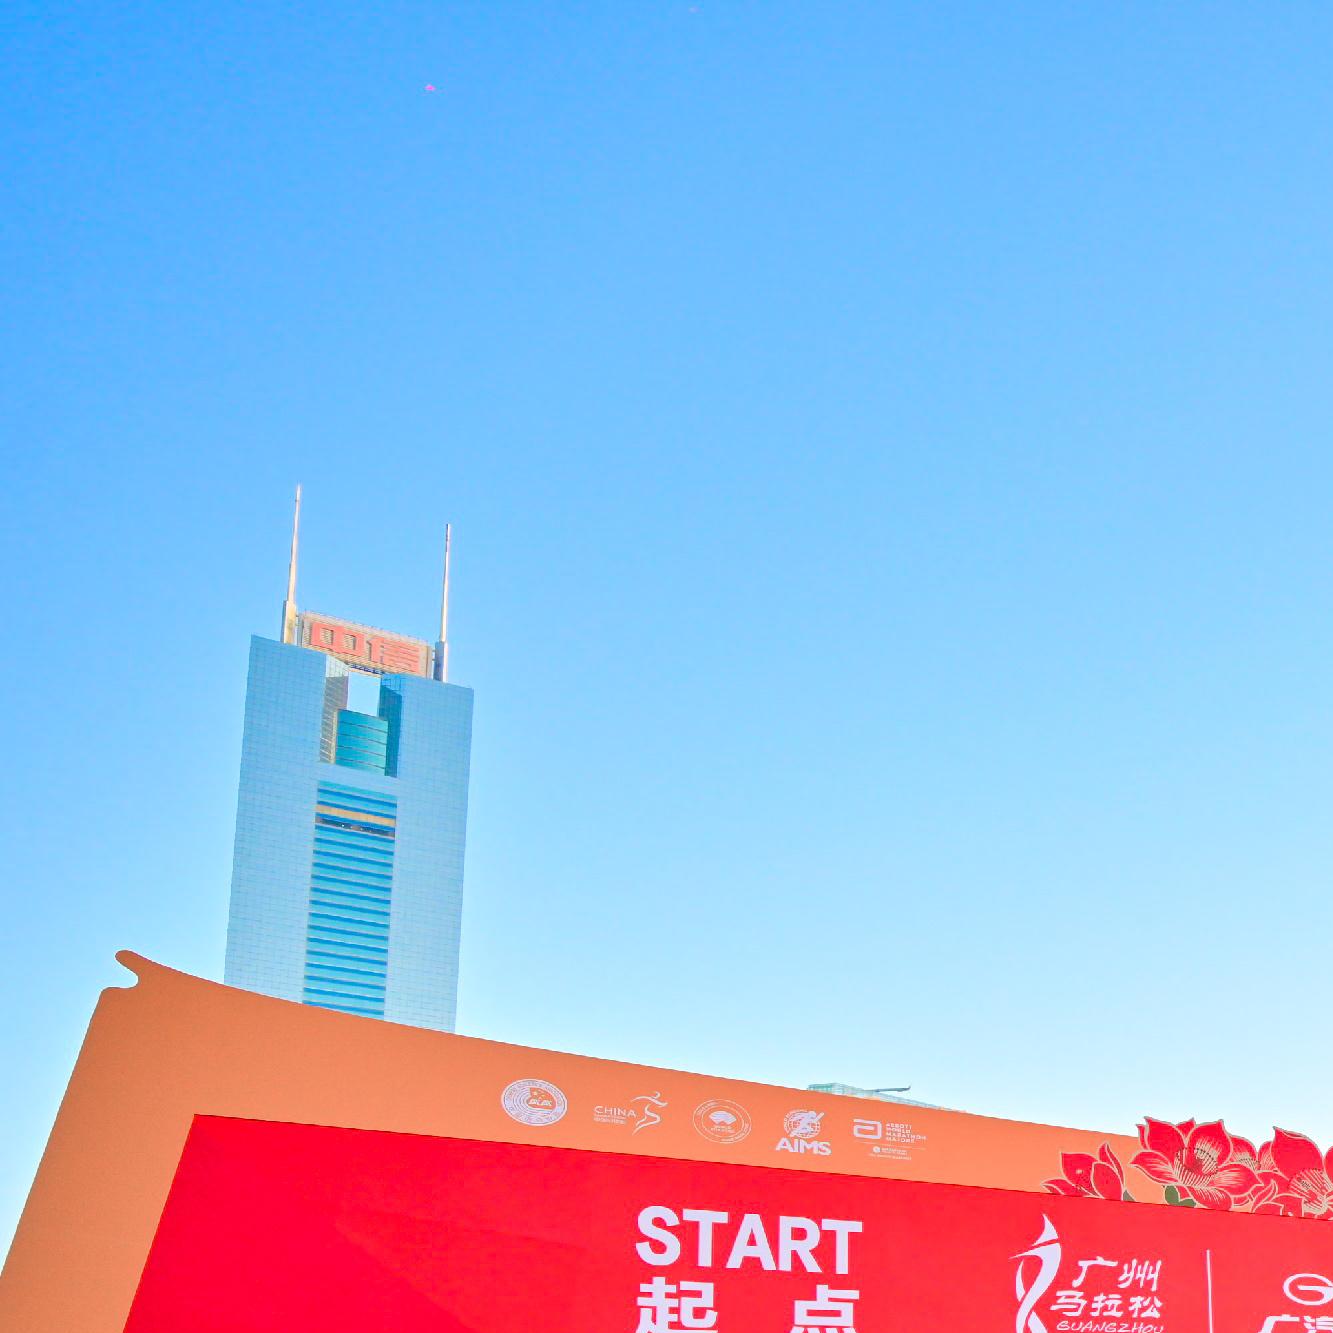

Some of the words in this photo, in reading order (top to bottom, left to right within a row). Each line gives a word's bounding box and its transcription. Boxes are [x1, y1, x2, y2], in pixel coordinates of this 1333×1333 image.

[311, 622, 420, 673] 中信
[594, 1105, 637, 1118] CHINA
[775, 1138, 832, 1156] AIMS
[635, 1206, 863, 1275] START
[1072, 1256, 1161, 1289] 广州
[1050, 1290, 1162, 1319] 马拉松
